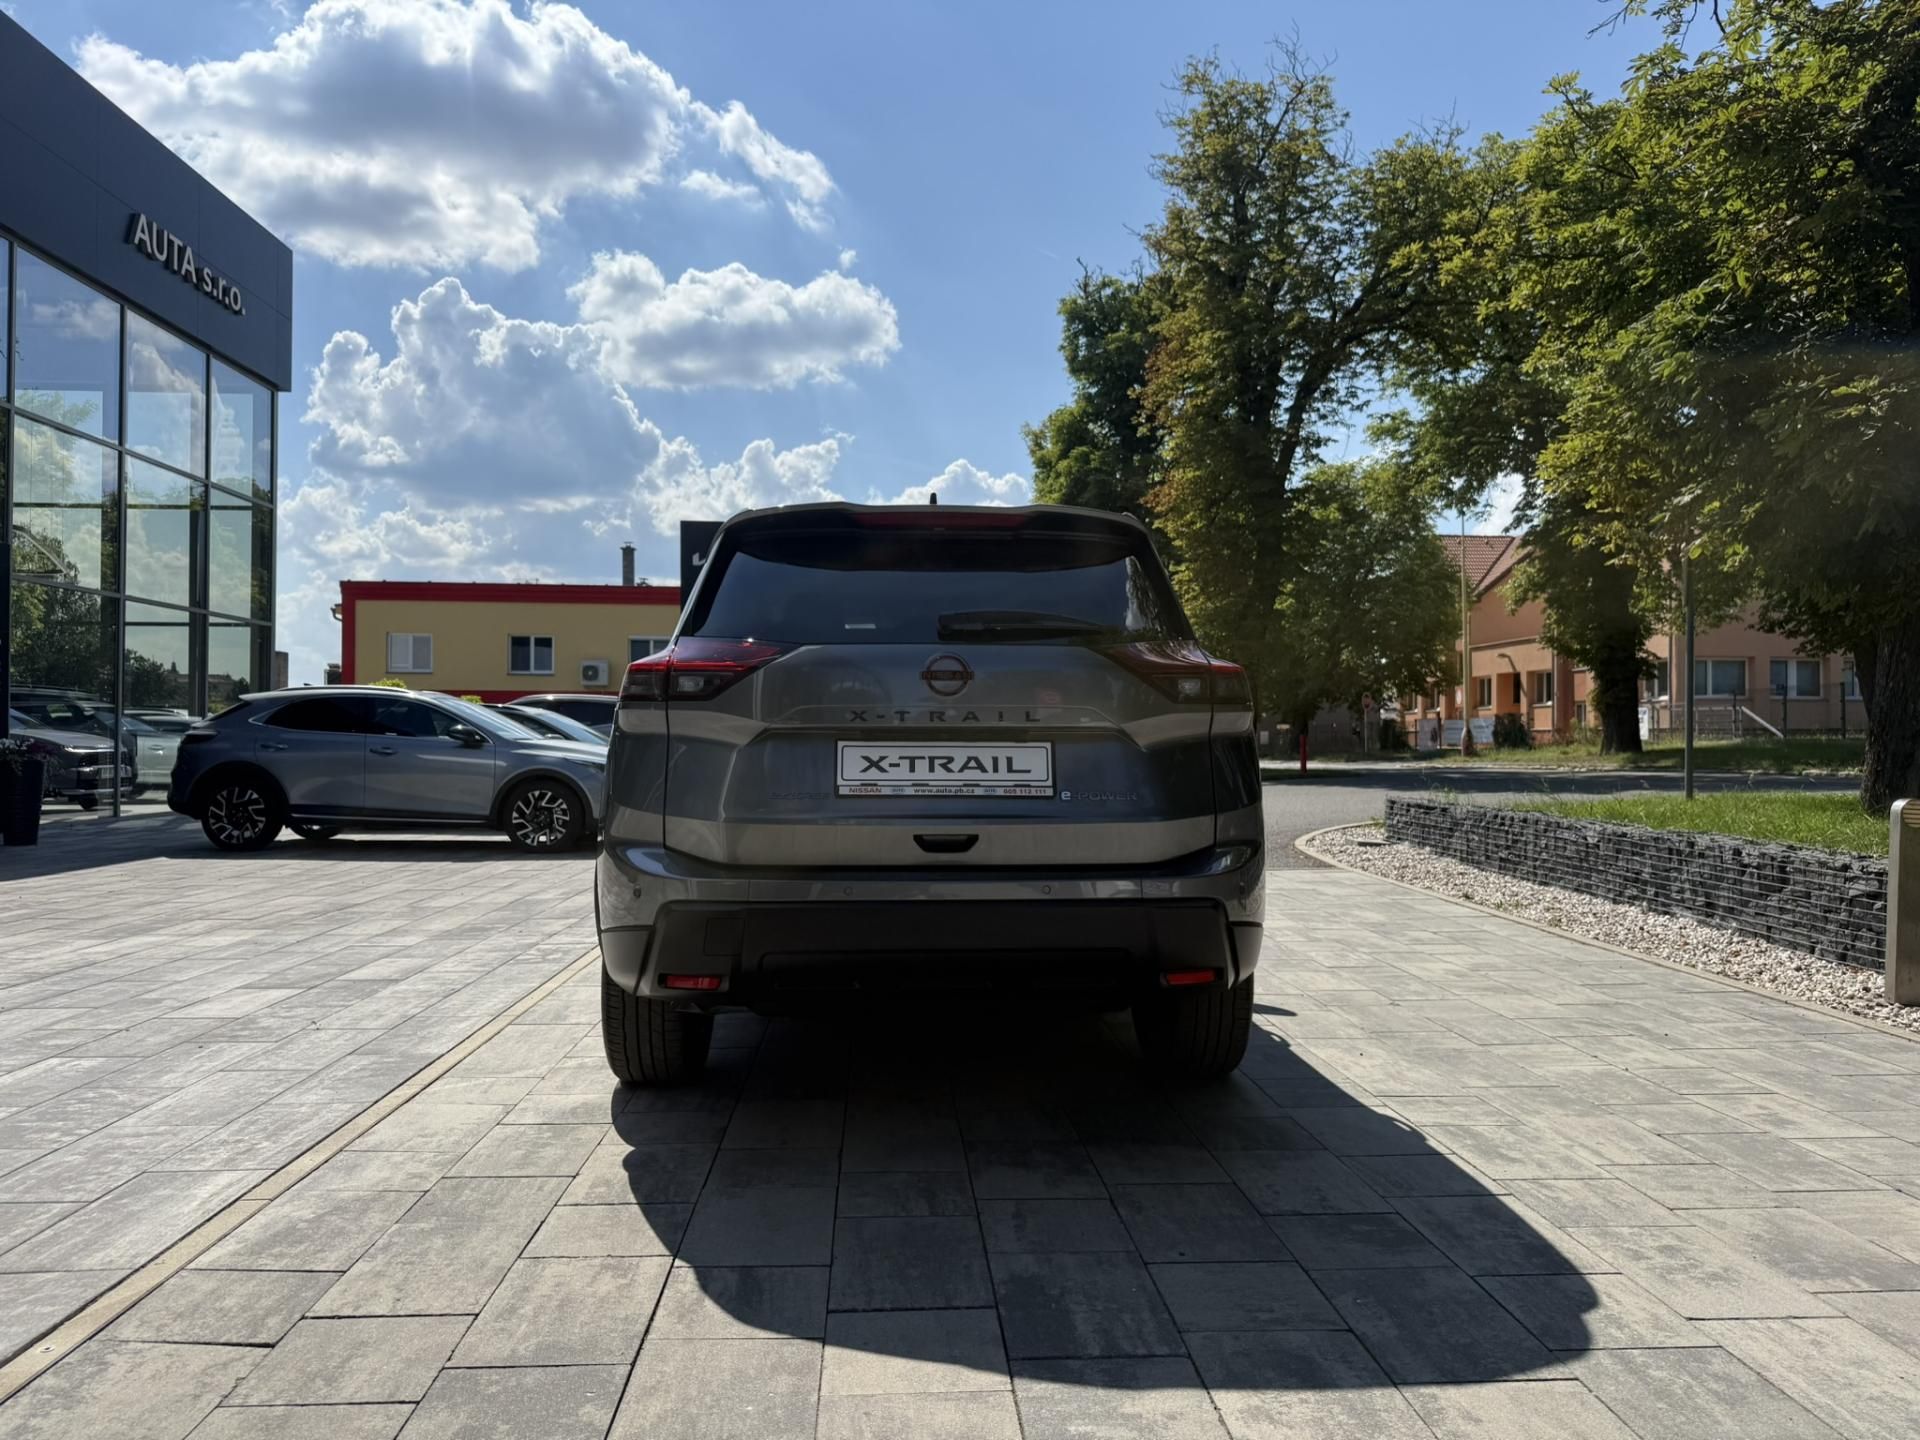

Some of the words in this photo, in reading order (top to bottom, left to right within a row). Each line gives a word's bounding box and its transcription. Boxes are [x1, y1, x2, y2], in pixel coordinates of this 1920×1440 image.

[133, 213, 197, 284] AUTA
[202, 266, 246, 315] s.r.o.
[849, 710, 1041, 722] X-TRAIL
[859, 755, 1032, 774] X-TRAIL
